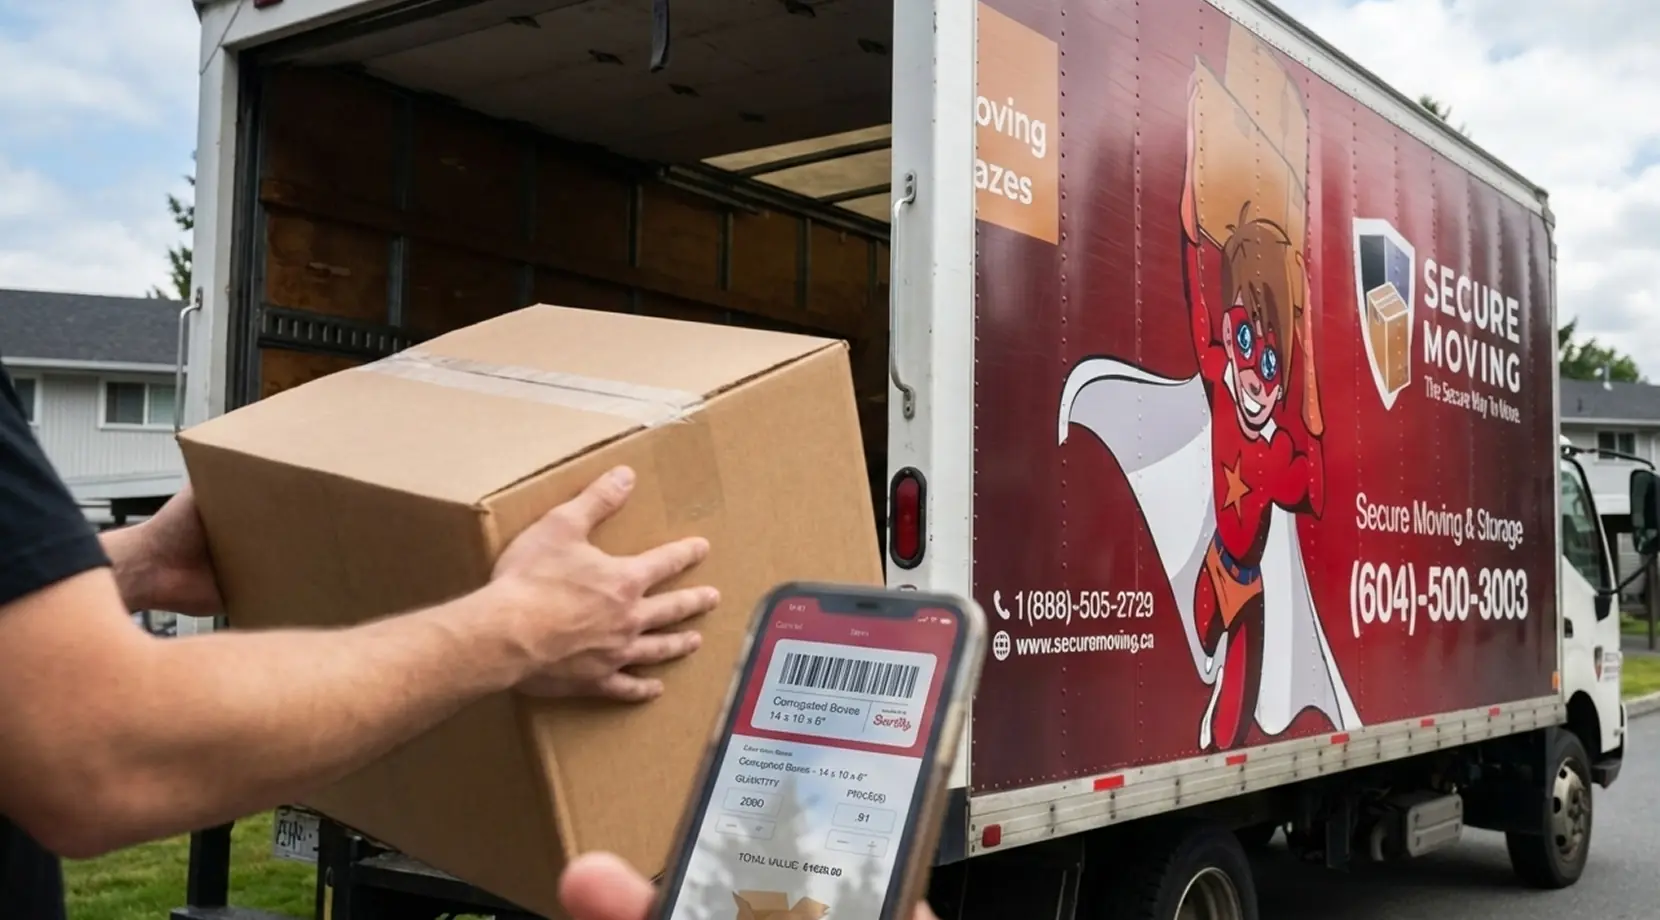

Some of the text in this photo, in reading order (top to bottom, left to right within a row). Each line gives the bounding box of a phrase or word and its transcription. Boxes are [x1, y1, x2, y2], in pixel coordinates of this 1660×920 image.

[1424, 258, 1520, 344] SECURE
[1424, 320, 1520, 393] MOVING
[1356, 492, 1524, 550] Secure Moving & Storage
[1014, 589, 1154, 627] 1(888)-505-2729
[1350, 560, 1529, 638] (604)-500-3003
[1016, 630, 1154, 655] www.securemoving.ca
